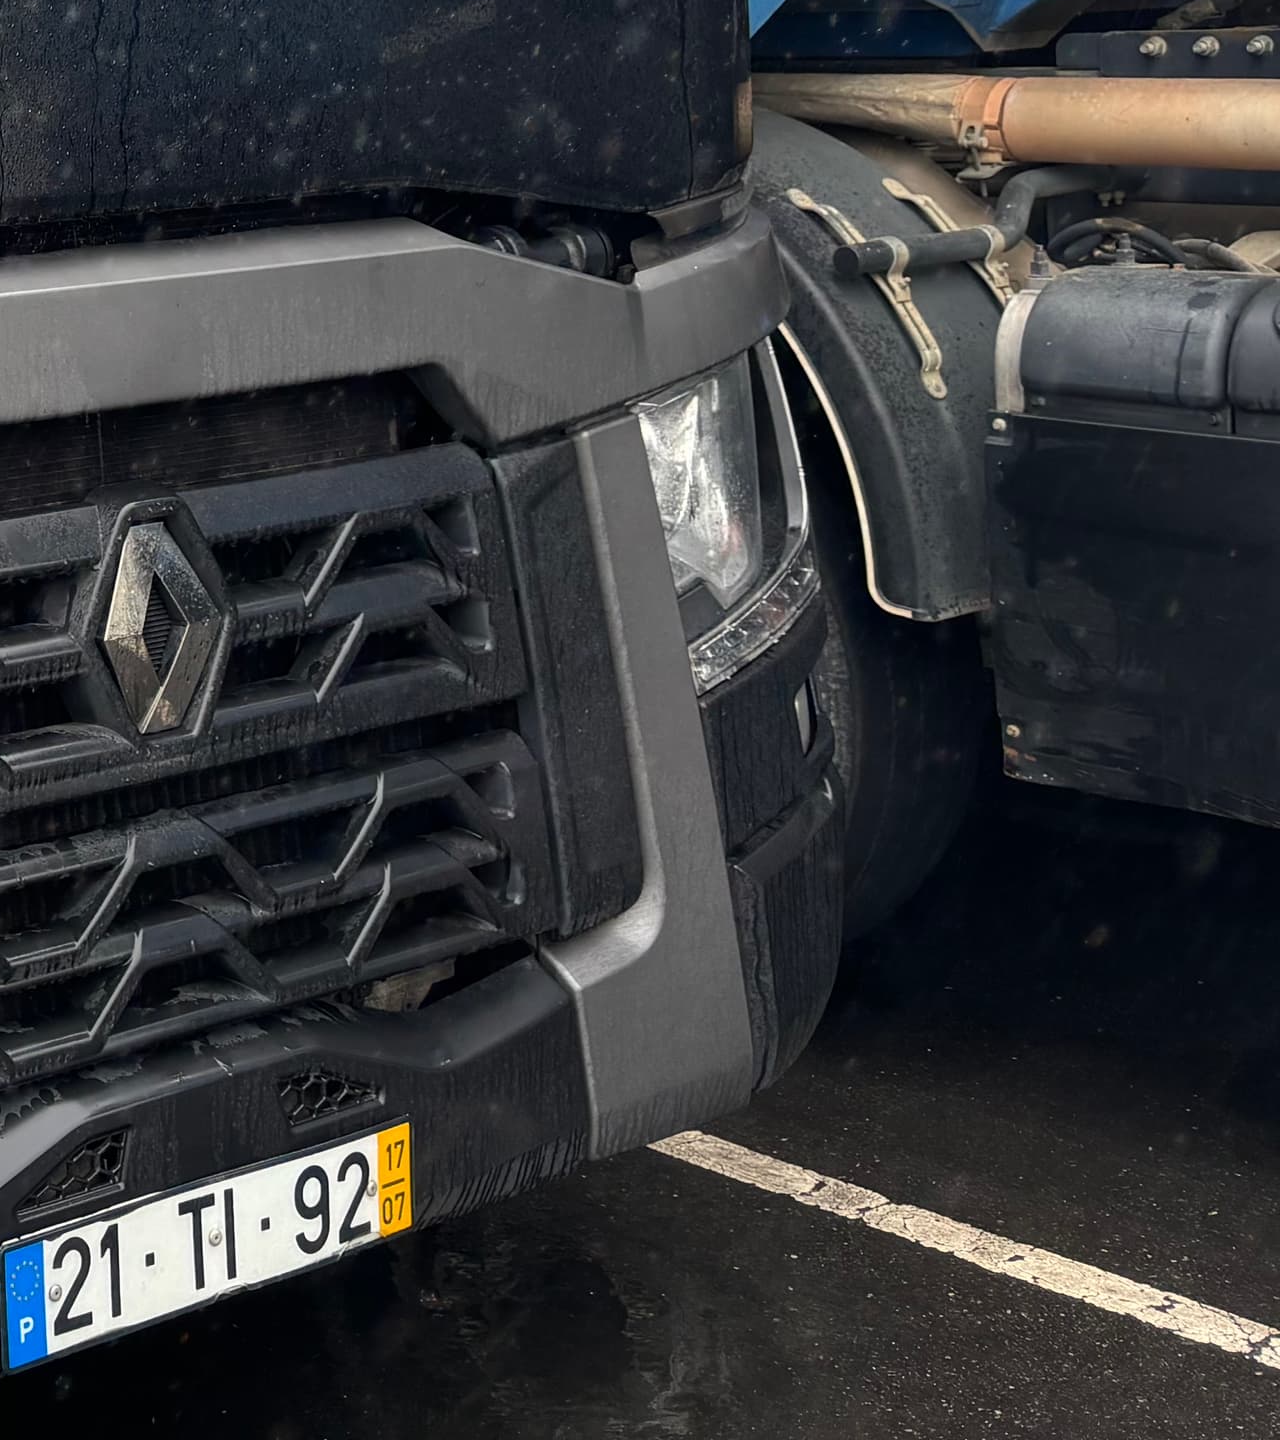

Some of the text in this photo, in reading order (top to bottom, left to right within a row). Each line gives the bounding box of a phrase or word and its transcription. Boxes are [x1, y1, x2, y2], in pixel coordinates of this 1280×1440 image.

[385, 1140, 406, 1172] 17
[382, 1192, 406, 1225] 07
[19, 1316, 34, 1344] P
